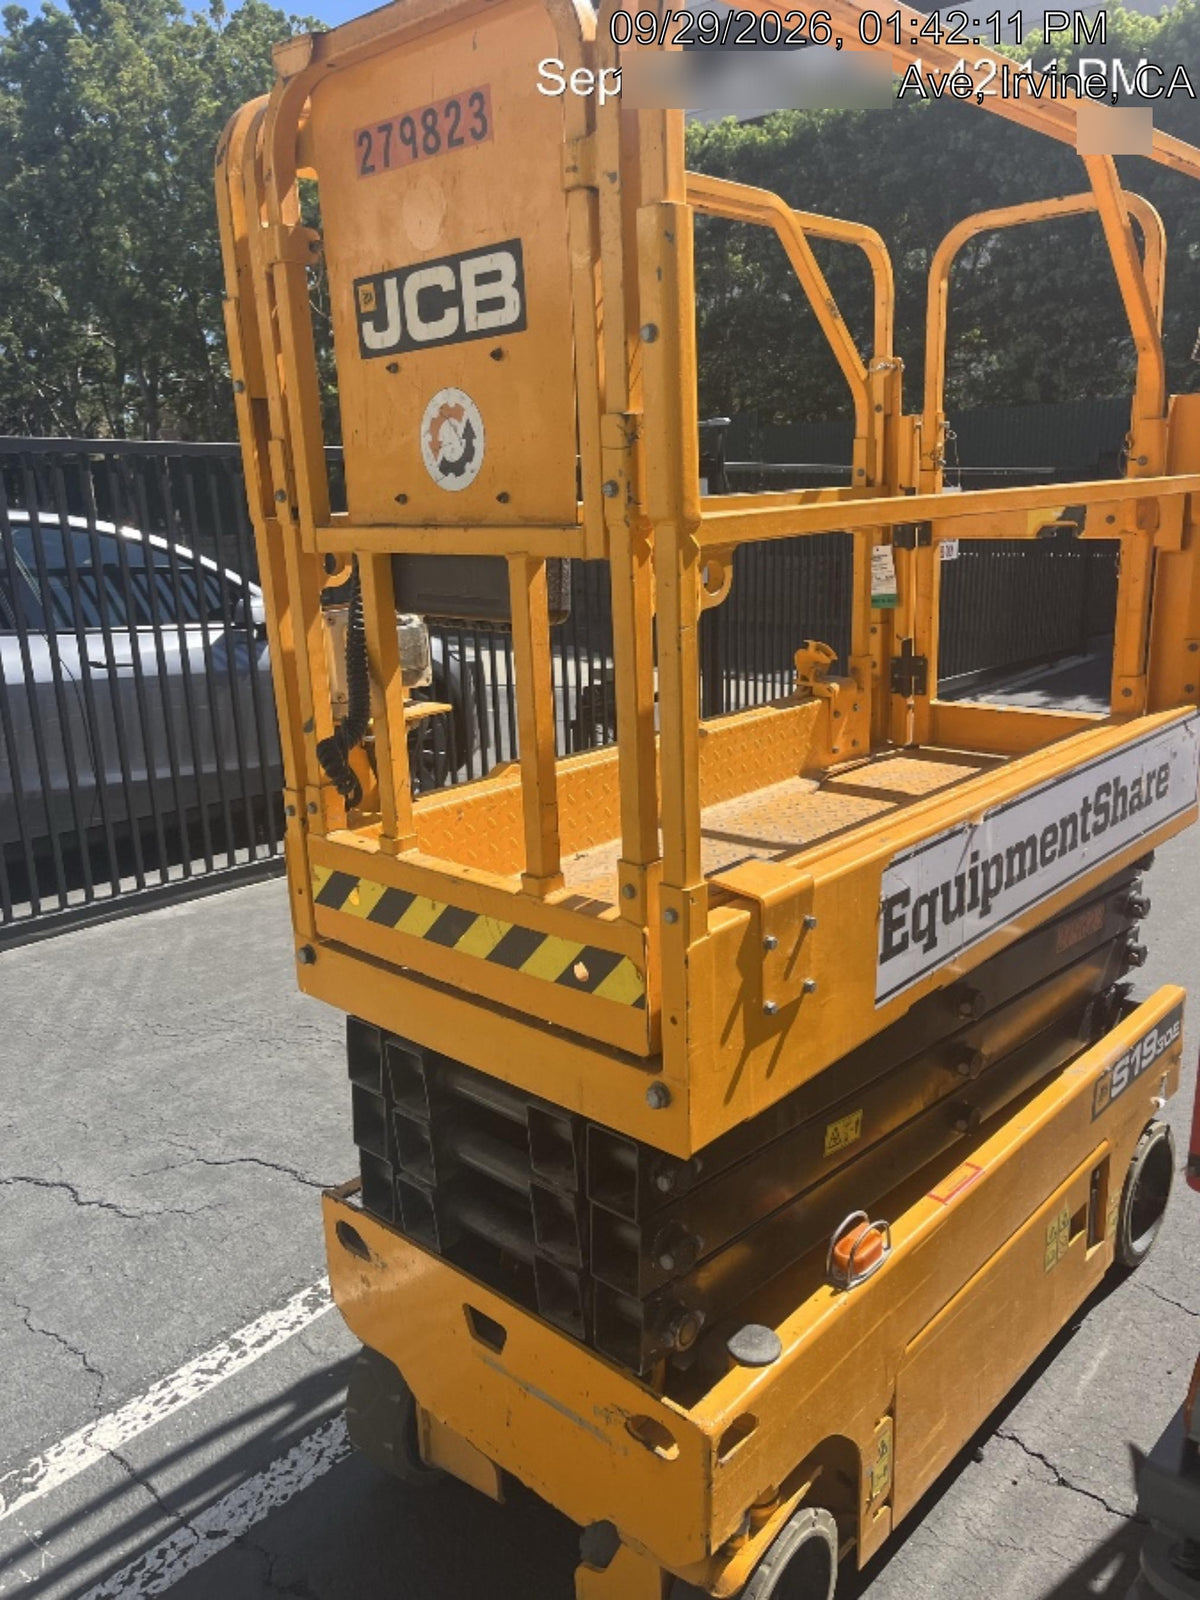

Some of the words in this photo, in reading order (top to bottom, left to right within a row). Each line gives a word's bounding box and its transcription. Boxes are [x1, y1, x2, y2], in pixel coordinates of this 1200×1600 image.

[356, 91, 488, 177] 279823
[361, 250, 521, 350] JCB
[879, 762, 1170, 966] EquipmentShare
